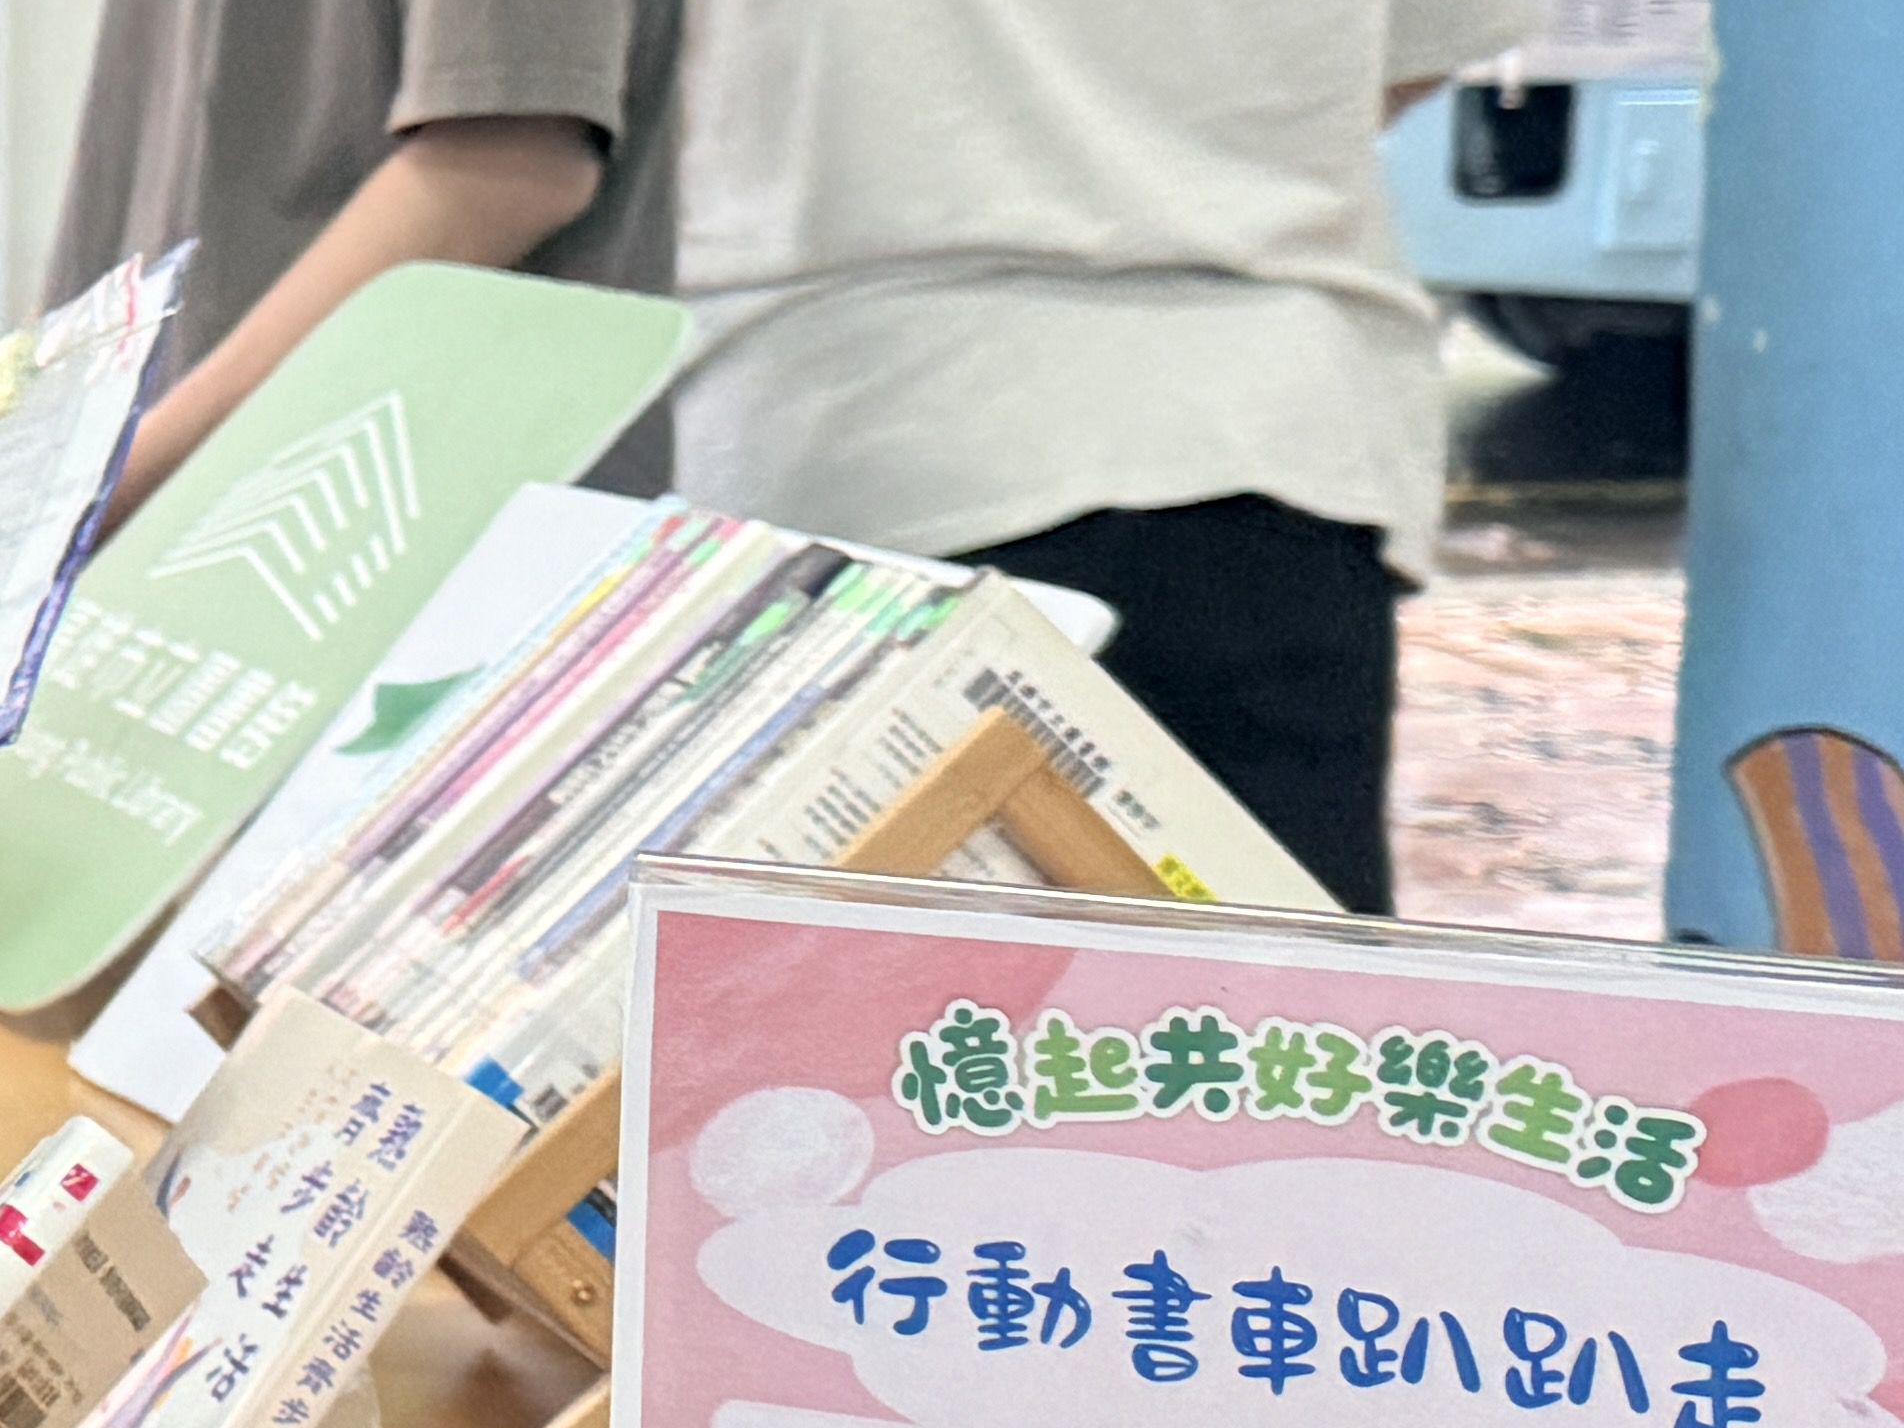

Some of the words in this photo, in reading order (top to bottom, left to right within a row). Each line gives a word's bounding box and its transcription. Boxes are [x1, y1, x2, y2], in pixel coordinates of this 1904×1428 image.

[902, 1006, 1698, 1206] 憶起共好樂生活
